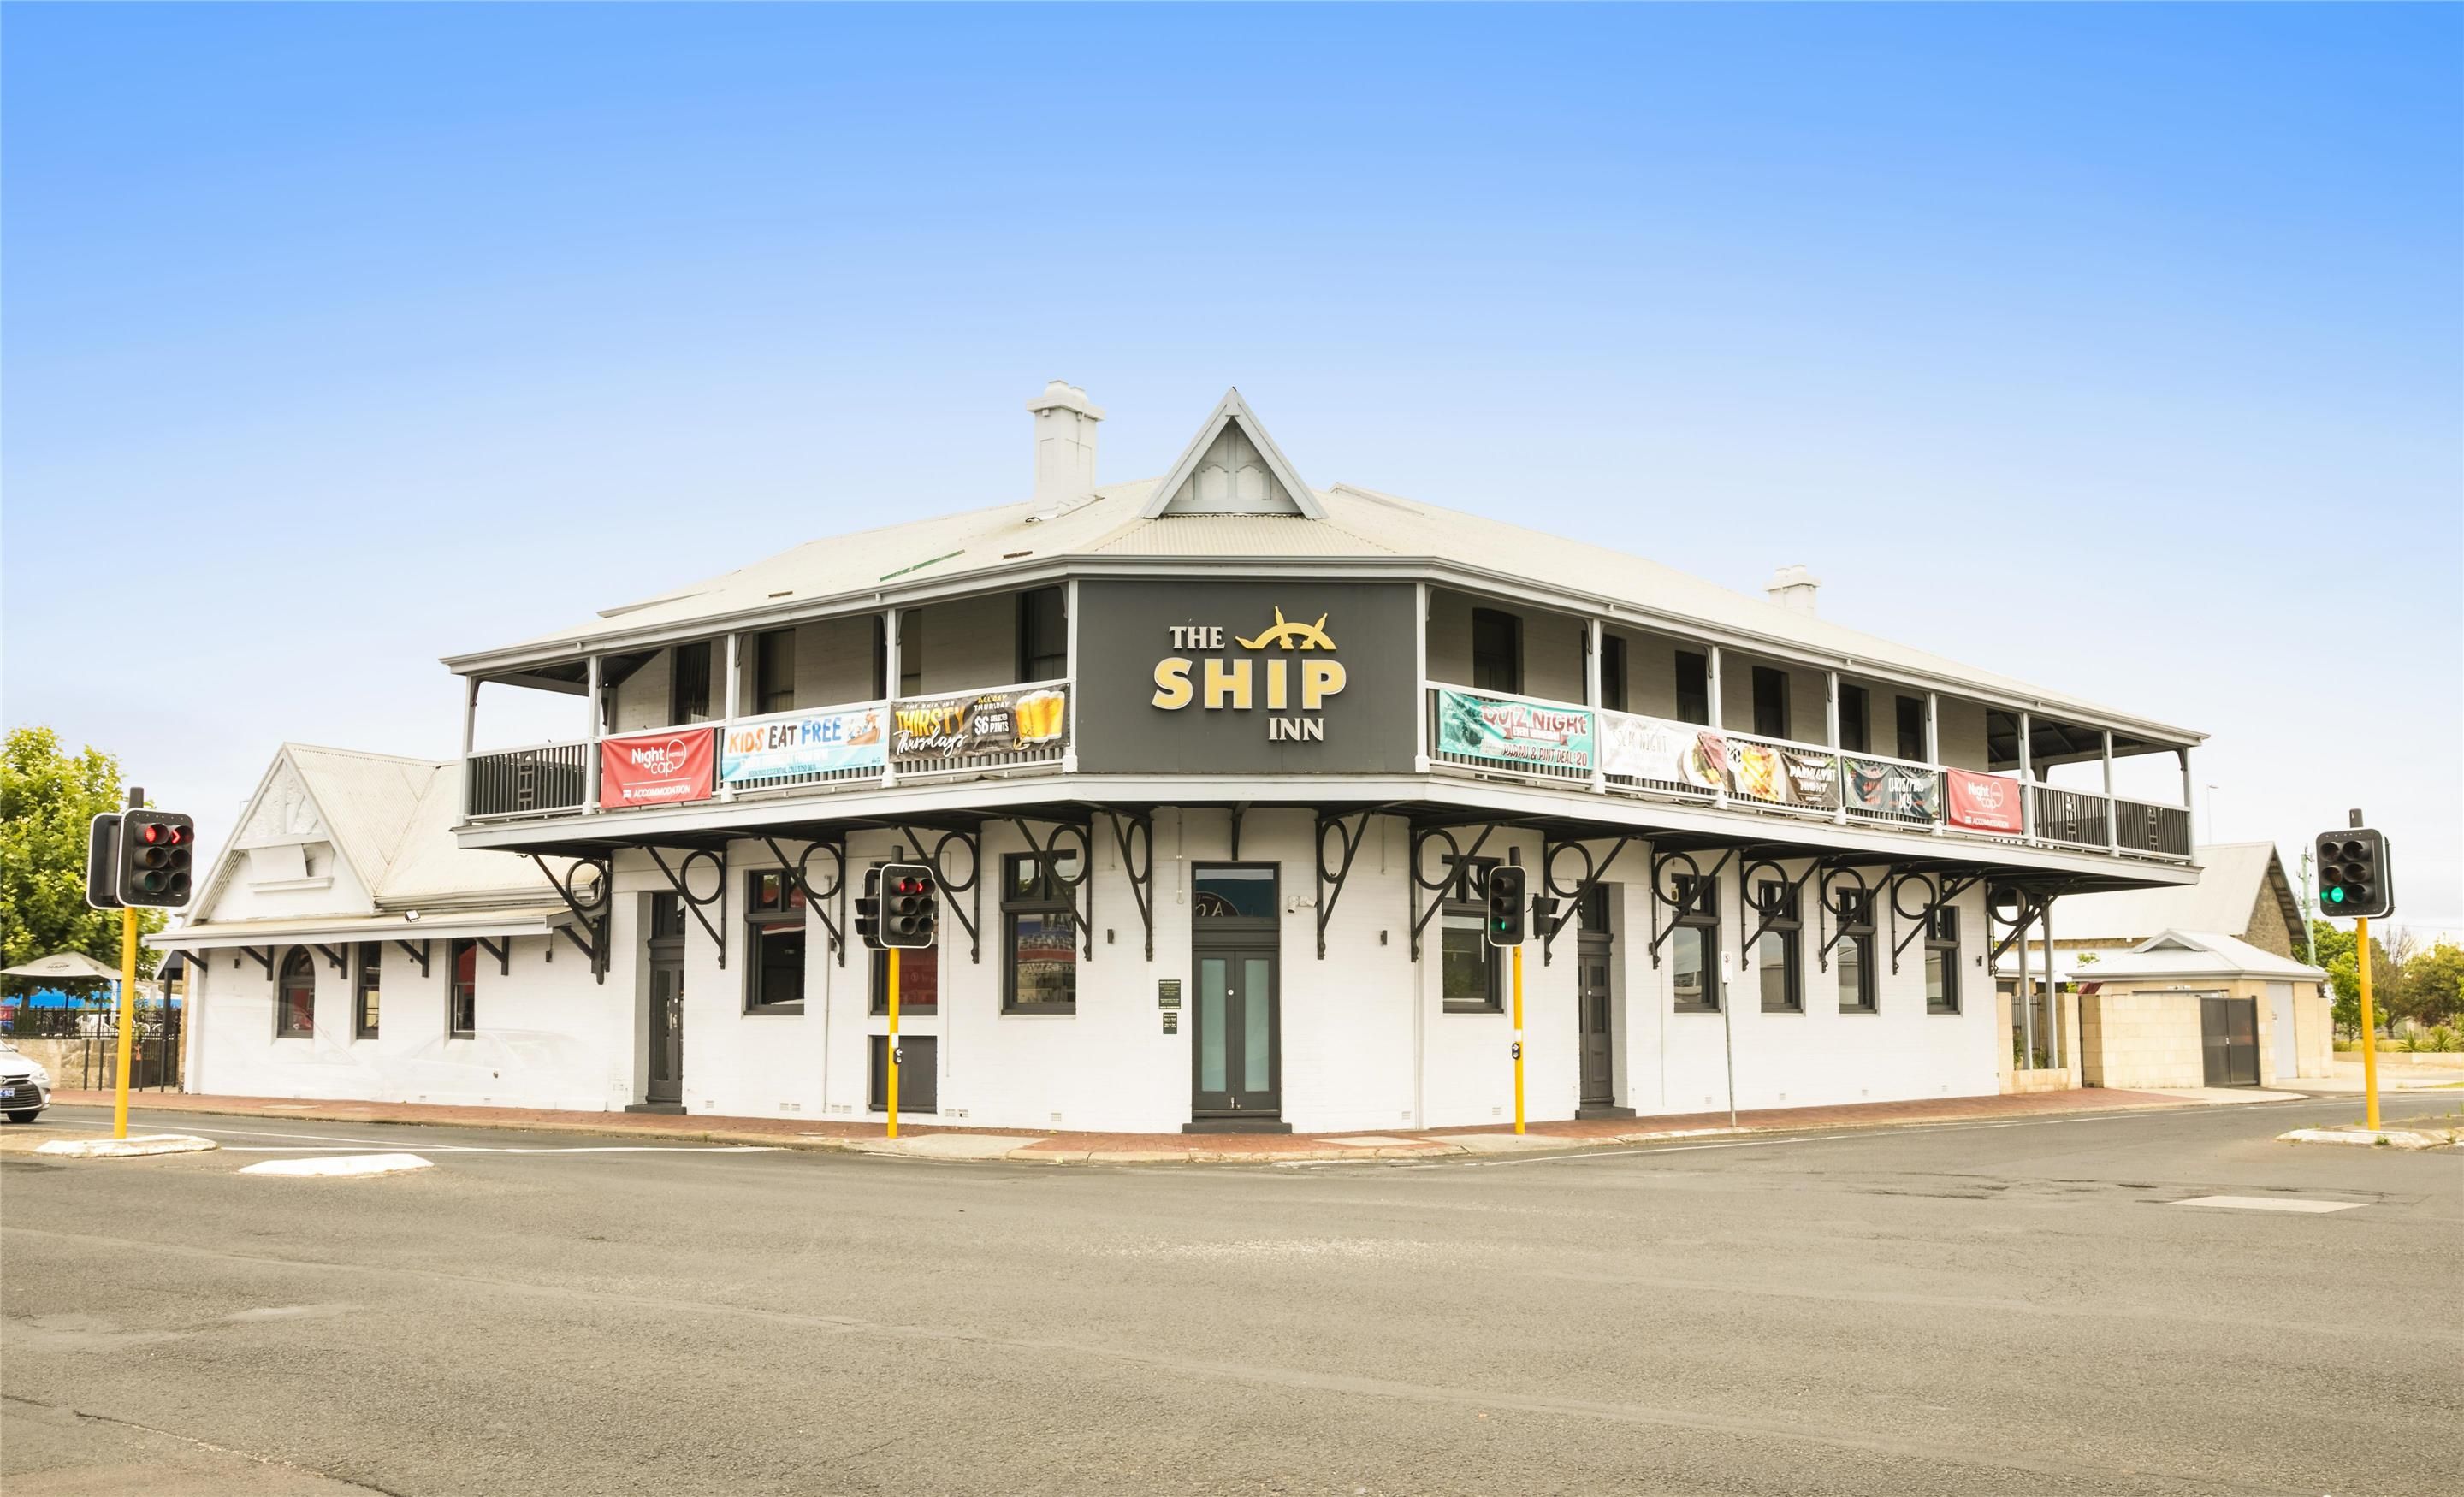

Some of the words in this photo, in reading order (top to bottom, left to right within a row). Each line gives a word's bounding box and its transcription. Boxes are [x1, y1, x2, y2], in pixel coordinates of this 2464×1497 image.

[1169, 626, 1226, 649] THE
[1152, 657, 1347, 710] SHIP
[895, 706, 966, 738] THIRSTY
[974, 715, 990, 735] $6
[990, 721, 1010, 733] PINTS
[1269, 717, 1324, 741] INN
[729, 727, 765, 754] KIDS
[768, 724, 797, 750] EAT
[801, 716, 842, 745] FREE
[892, 725, 968, 758] Thursdays
[631, 747, 665, 768] Night
[1502, 744, 1529, 759] PARMI
[1530, 746, 1537, 760] &
[1539, 747, 1555, 763] PINT
[1556, 749, 1573, 765] DEAL
[650, 760, 674, 778] cap
[633, 784, 691, 798] ACCOMMODATION
[1968, 781, 1990, 802] Night
